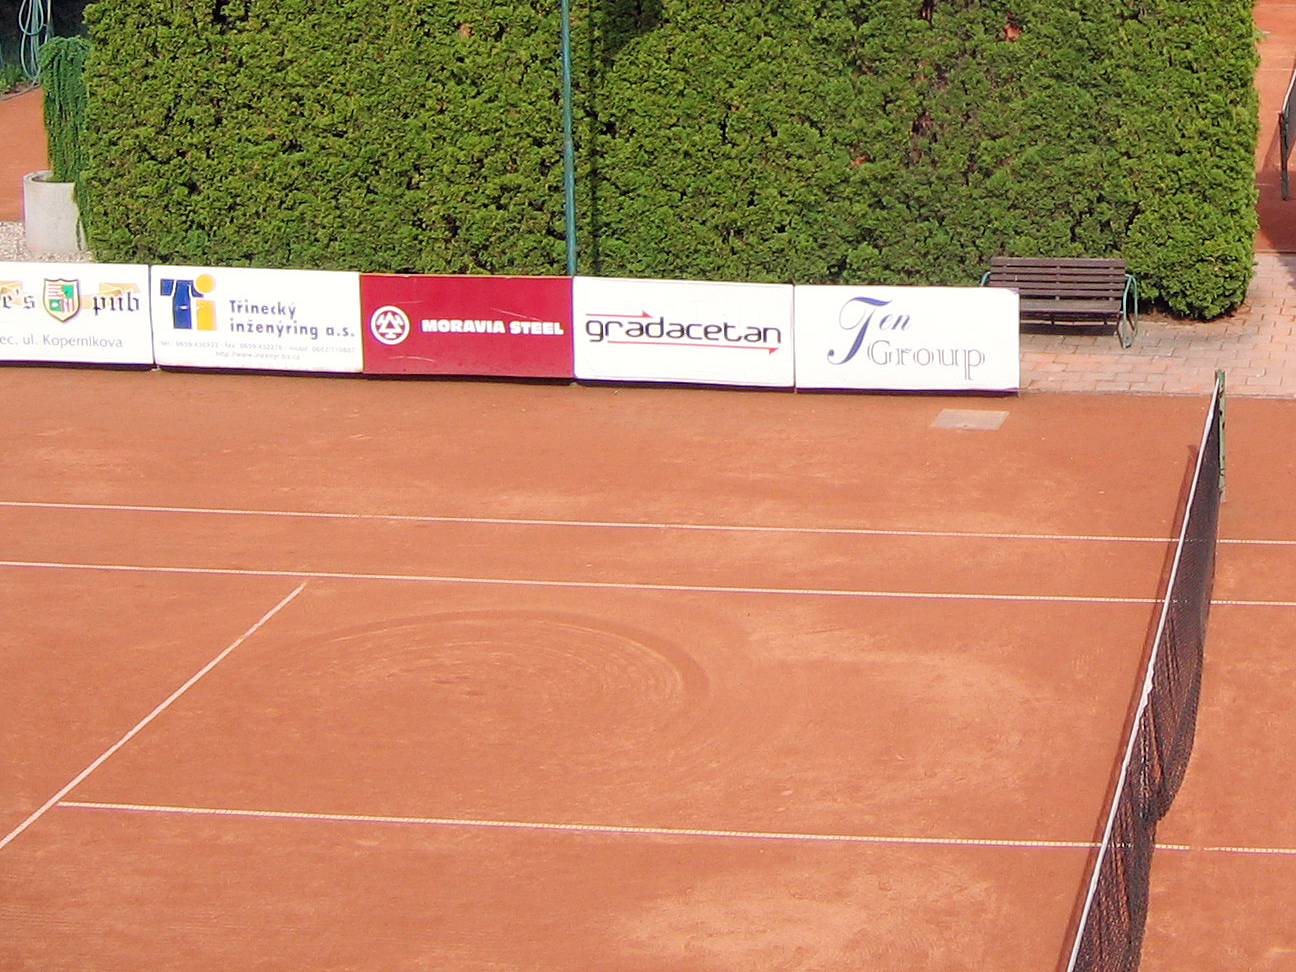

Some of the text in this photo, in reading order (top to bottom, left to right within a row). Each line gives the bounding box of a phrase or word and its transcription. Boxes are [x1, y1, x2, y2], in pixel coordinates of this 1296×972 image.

[92, 290, 140, 316] pub
[229, 298, 297, 320] Třinecký
[230, 317, 355, 340] inženýring a.s.
[421, 319, 565, 335] MORAVIA STEEL
[585, 316, 782, 343] gradacetan
[826, 295, 912, 366] Ten
[23, 333, 38, 346] ul.
[867, 339, 986, 381] Group
